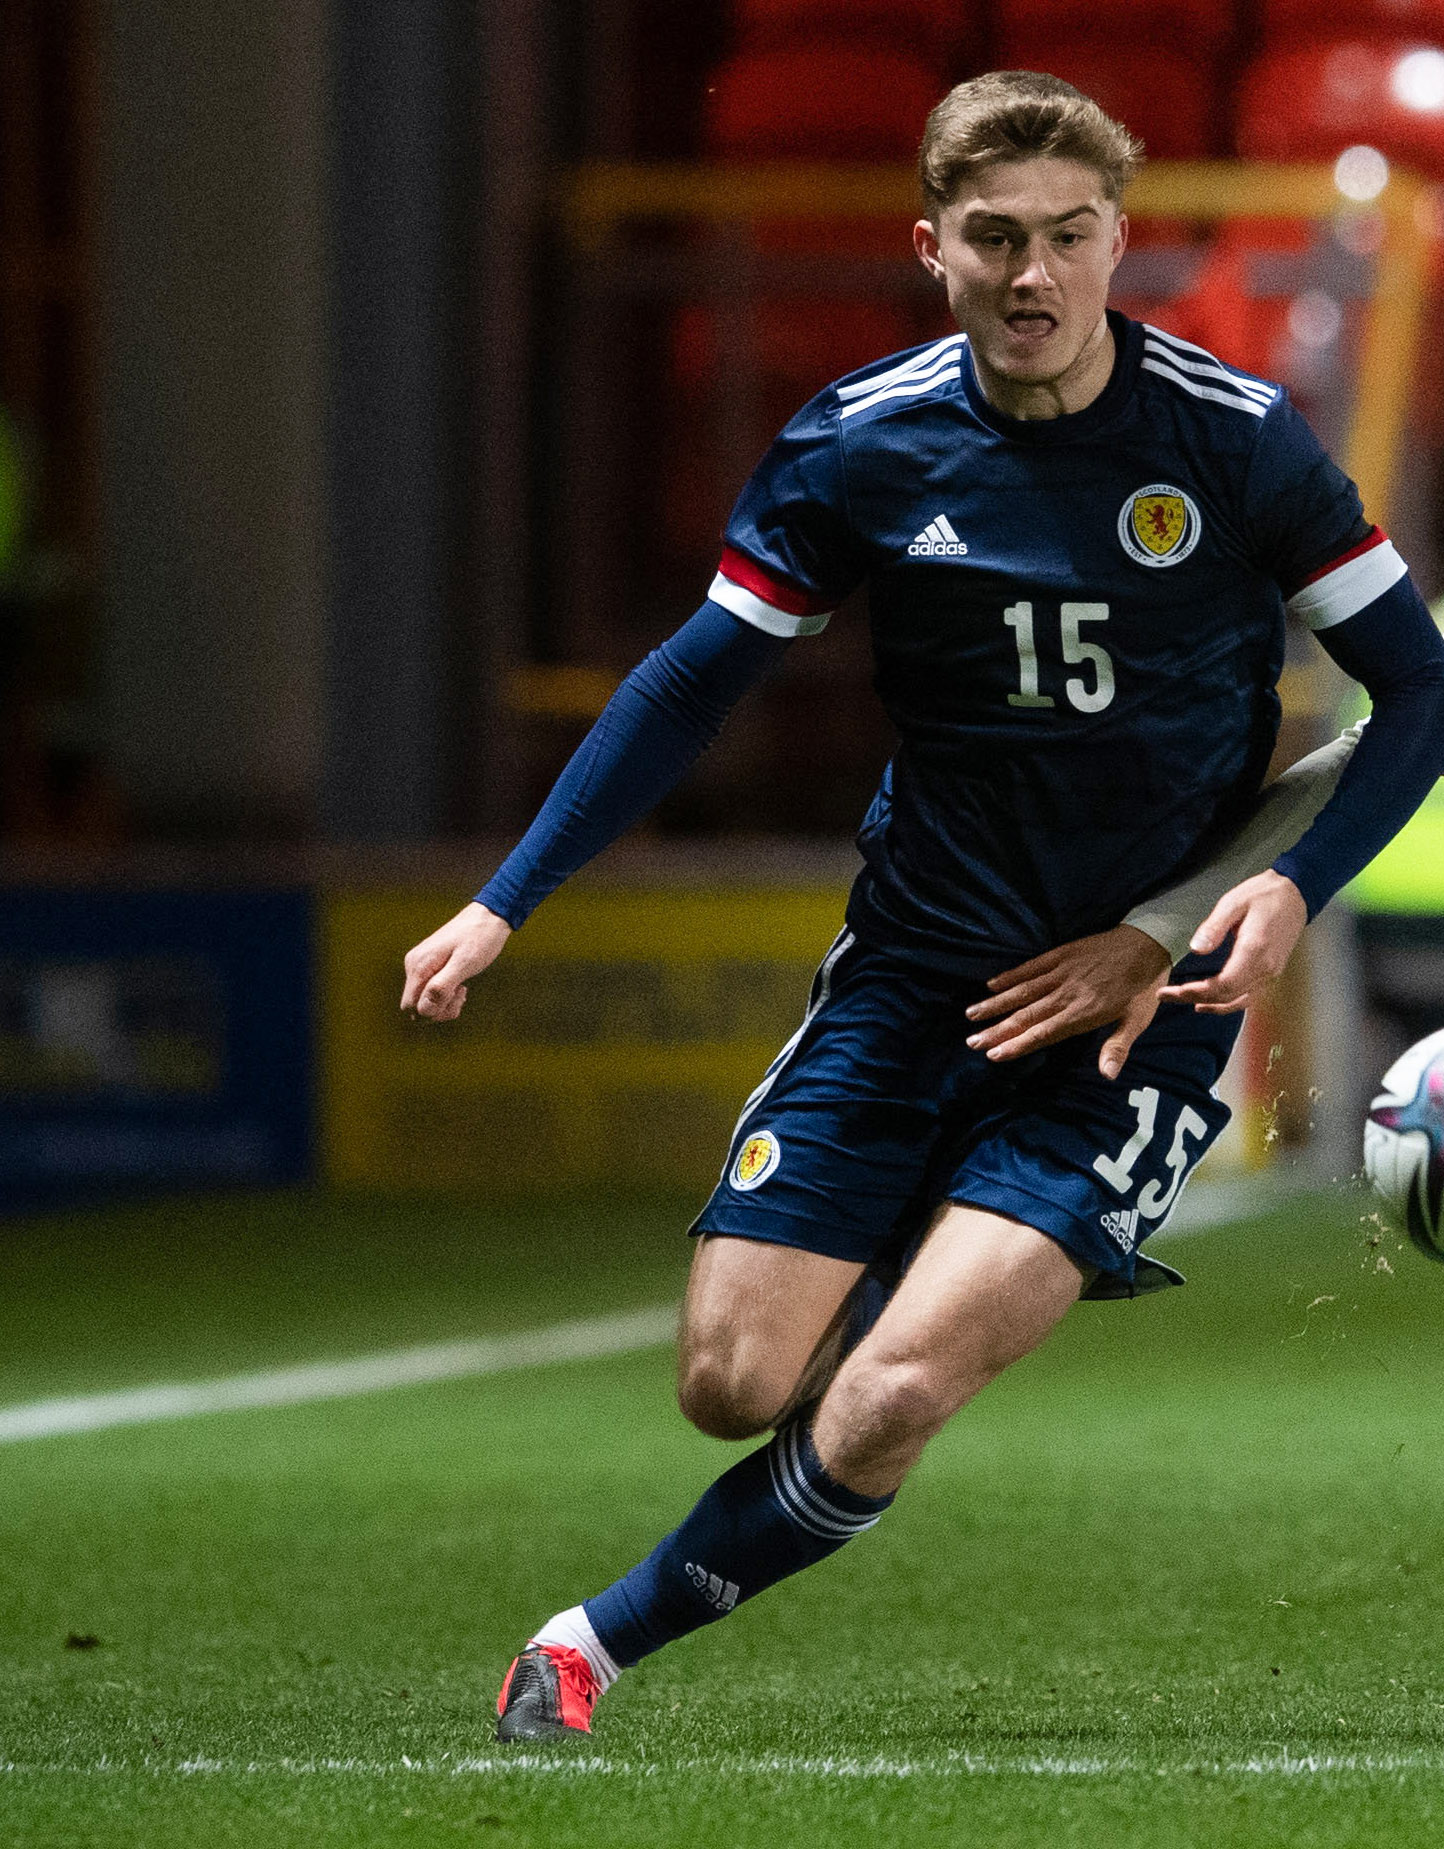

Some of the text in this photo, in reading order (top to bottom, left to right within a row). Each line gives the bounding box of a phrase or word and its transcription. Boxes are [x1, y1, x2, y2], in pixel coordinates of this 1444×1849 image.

[1138, 486, 1179, 497] SCOTLAND
[907, 540, 968, 557] adidas
[1003, 600, 1116, 714] 15
[1092, 1086, 1208, 1219] 15
